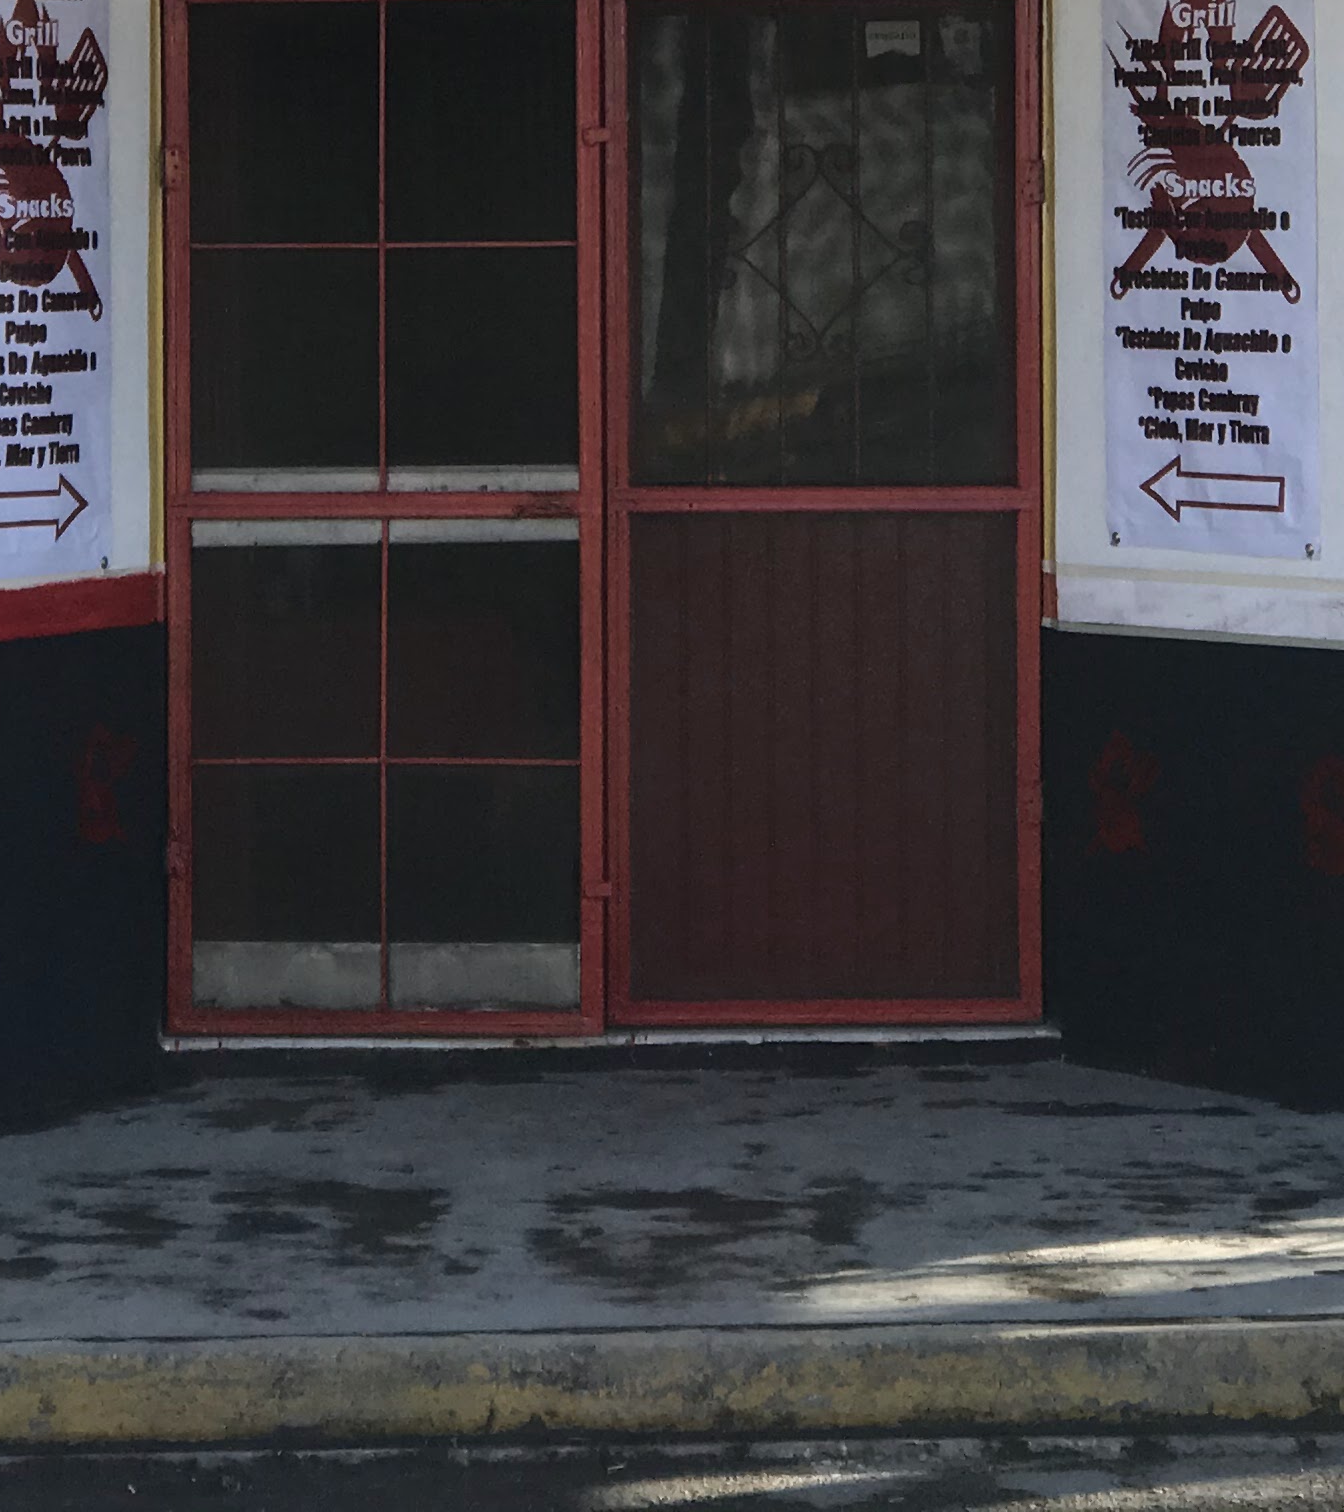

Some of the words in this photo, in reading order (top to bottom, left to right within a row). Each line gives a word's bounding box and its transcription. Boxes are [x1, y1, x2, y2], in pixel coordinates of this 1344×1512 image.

[6, 19, 59, 47] Grill
[1164, 172, 1256, 199] Snacks
[1180, 297, 1222, 323] Pulpo
